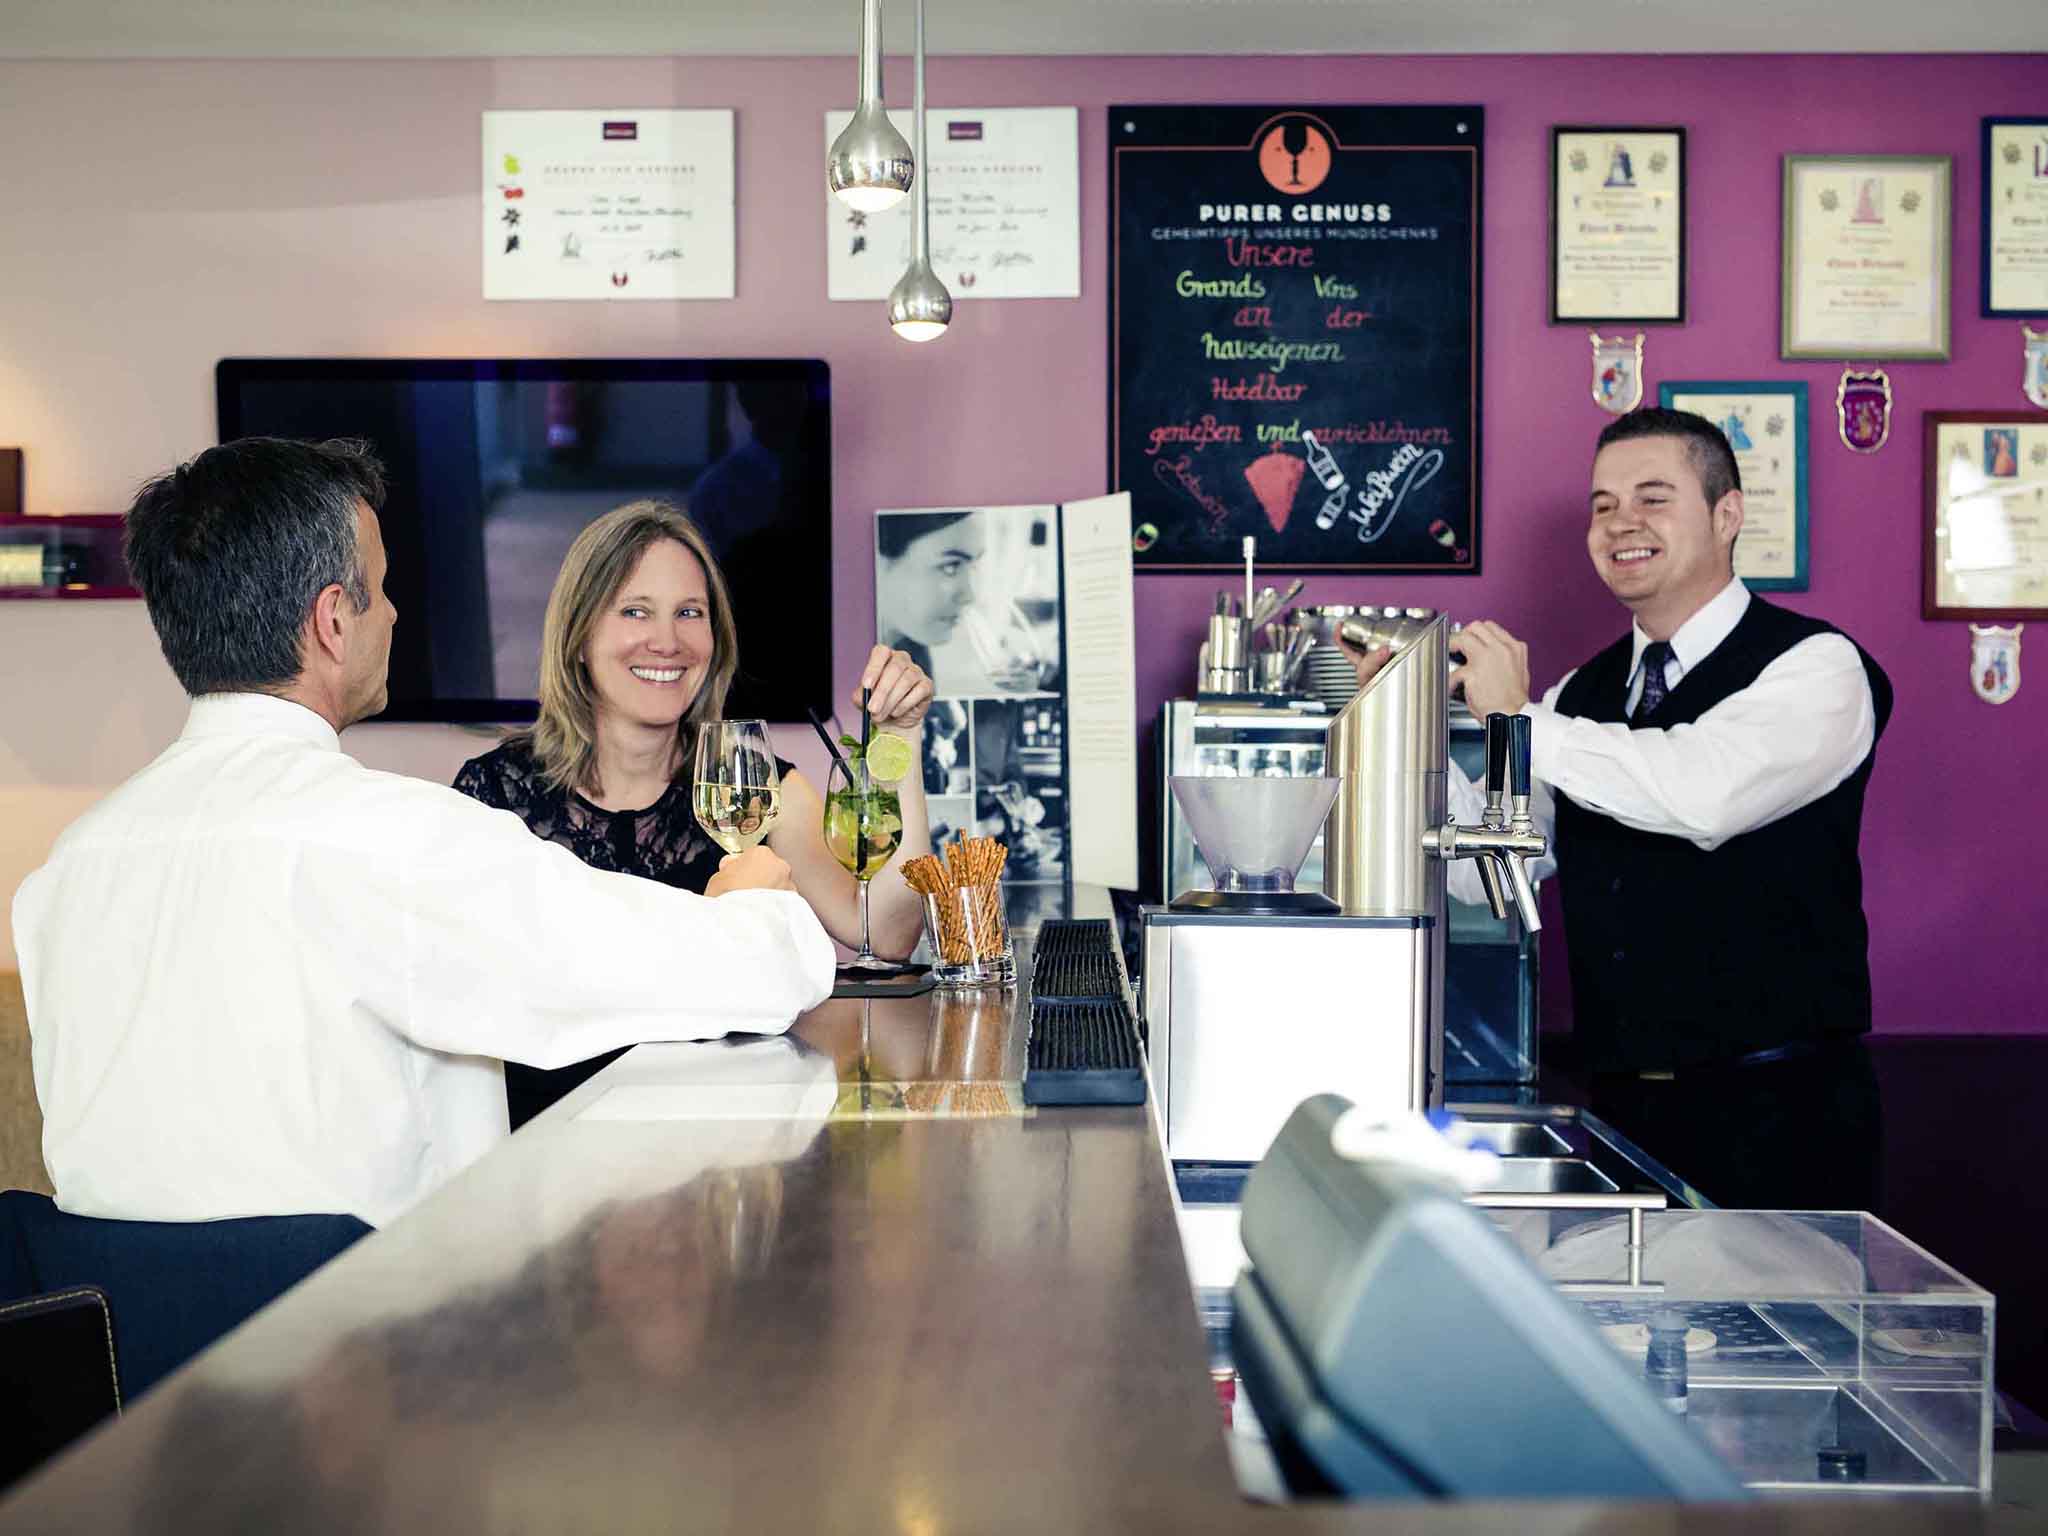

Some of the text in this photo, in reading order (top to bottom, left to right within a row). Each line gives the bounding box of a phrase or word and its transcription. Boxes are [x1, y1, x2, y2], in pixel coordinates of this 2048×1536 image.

[1199, 204, 1392, 223] PURER GENUSS
[1151, 228, 1439, 241] GEHEIMTIPPS UNSERES MUNDSCHENKS
[1223, 238, 1315, 267] Unsere
[1175, 269, 1359, 300] Grands Vins
[1233, 304, 1375, 329] an der
[1211, 372, 1308, 401] Hotelbar
[1144, 414, 1243, 455] genießen
[1256, 419, 1301, 443] und
